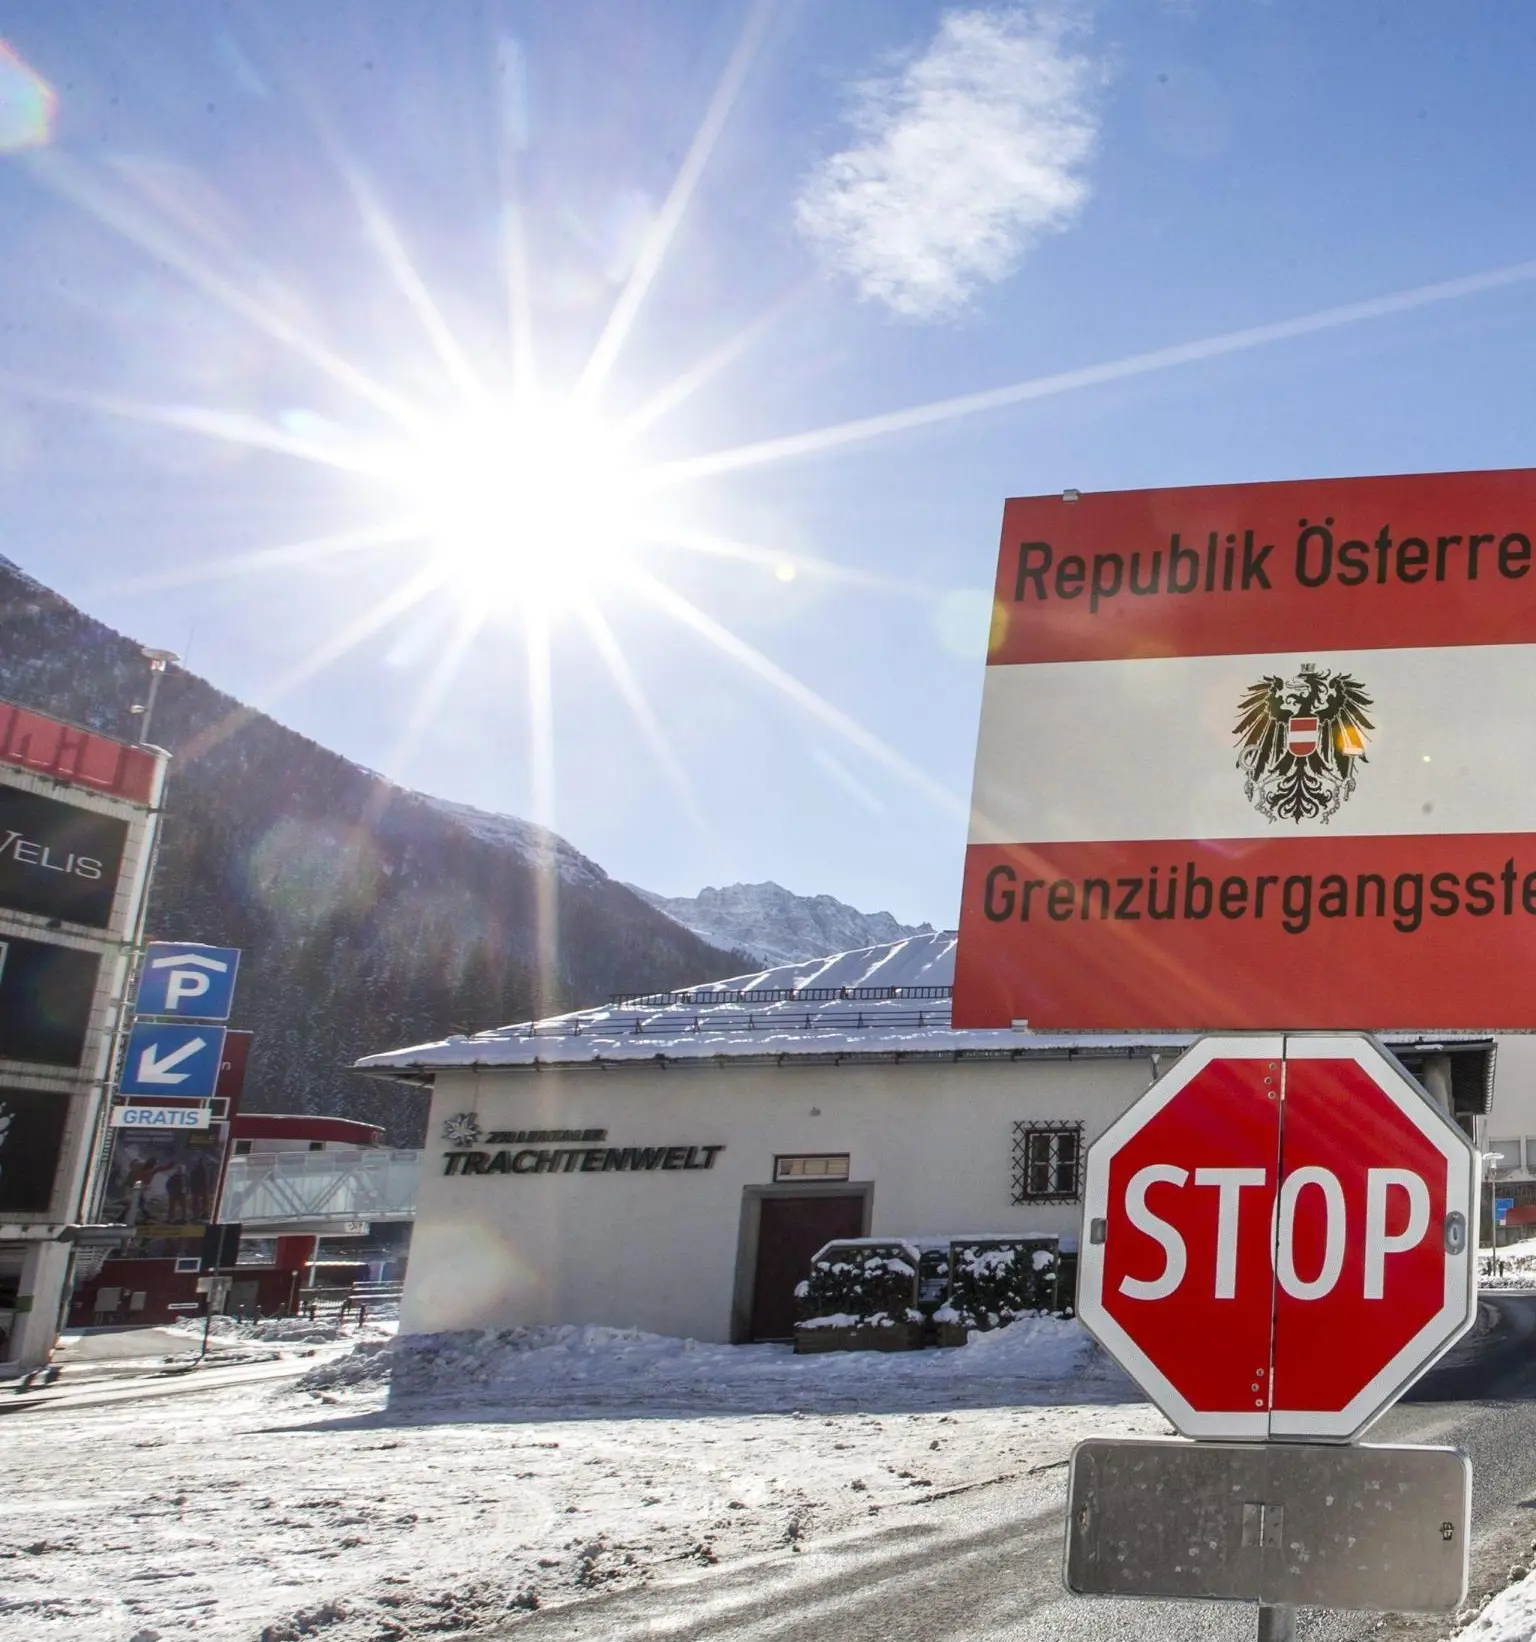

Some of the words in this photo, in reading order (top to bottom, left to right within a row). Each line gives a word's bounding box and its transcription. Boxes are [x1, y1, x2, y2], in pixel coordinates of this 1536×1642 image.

[1012, 528, 1275, 613] Republik
[164, 970, 210, 1010] P
[123, 1109, 199, 1126] GRATIS
[443, 1145, 726, 1176] TRACHTENWELT
[1118, 1163, 1432, 1302] STOP
